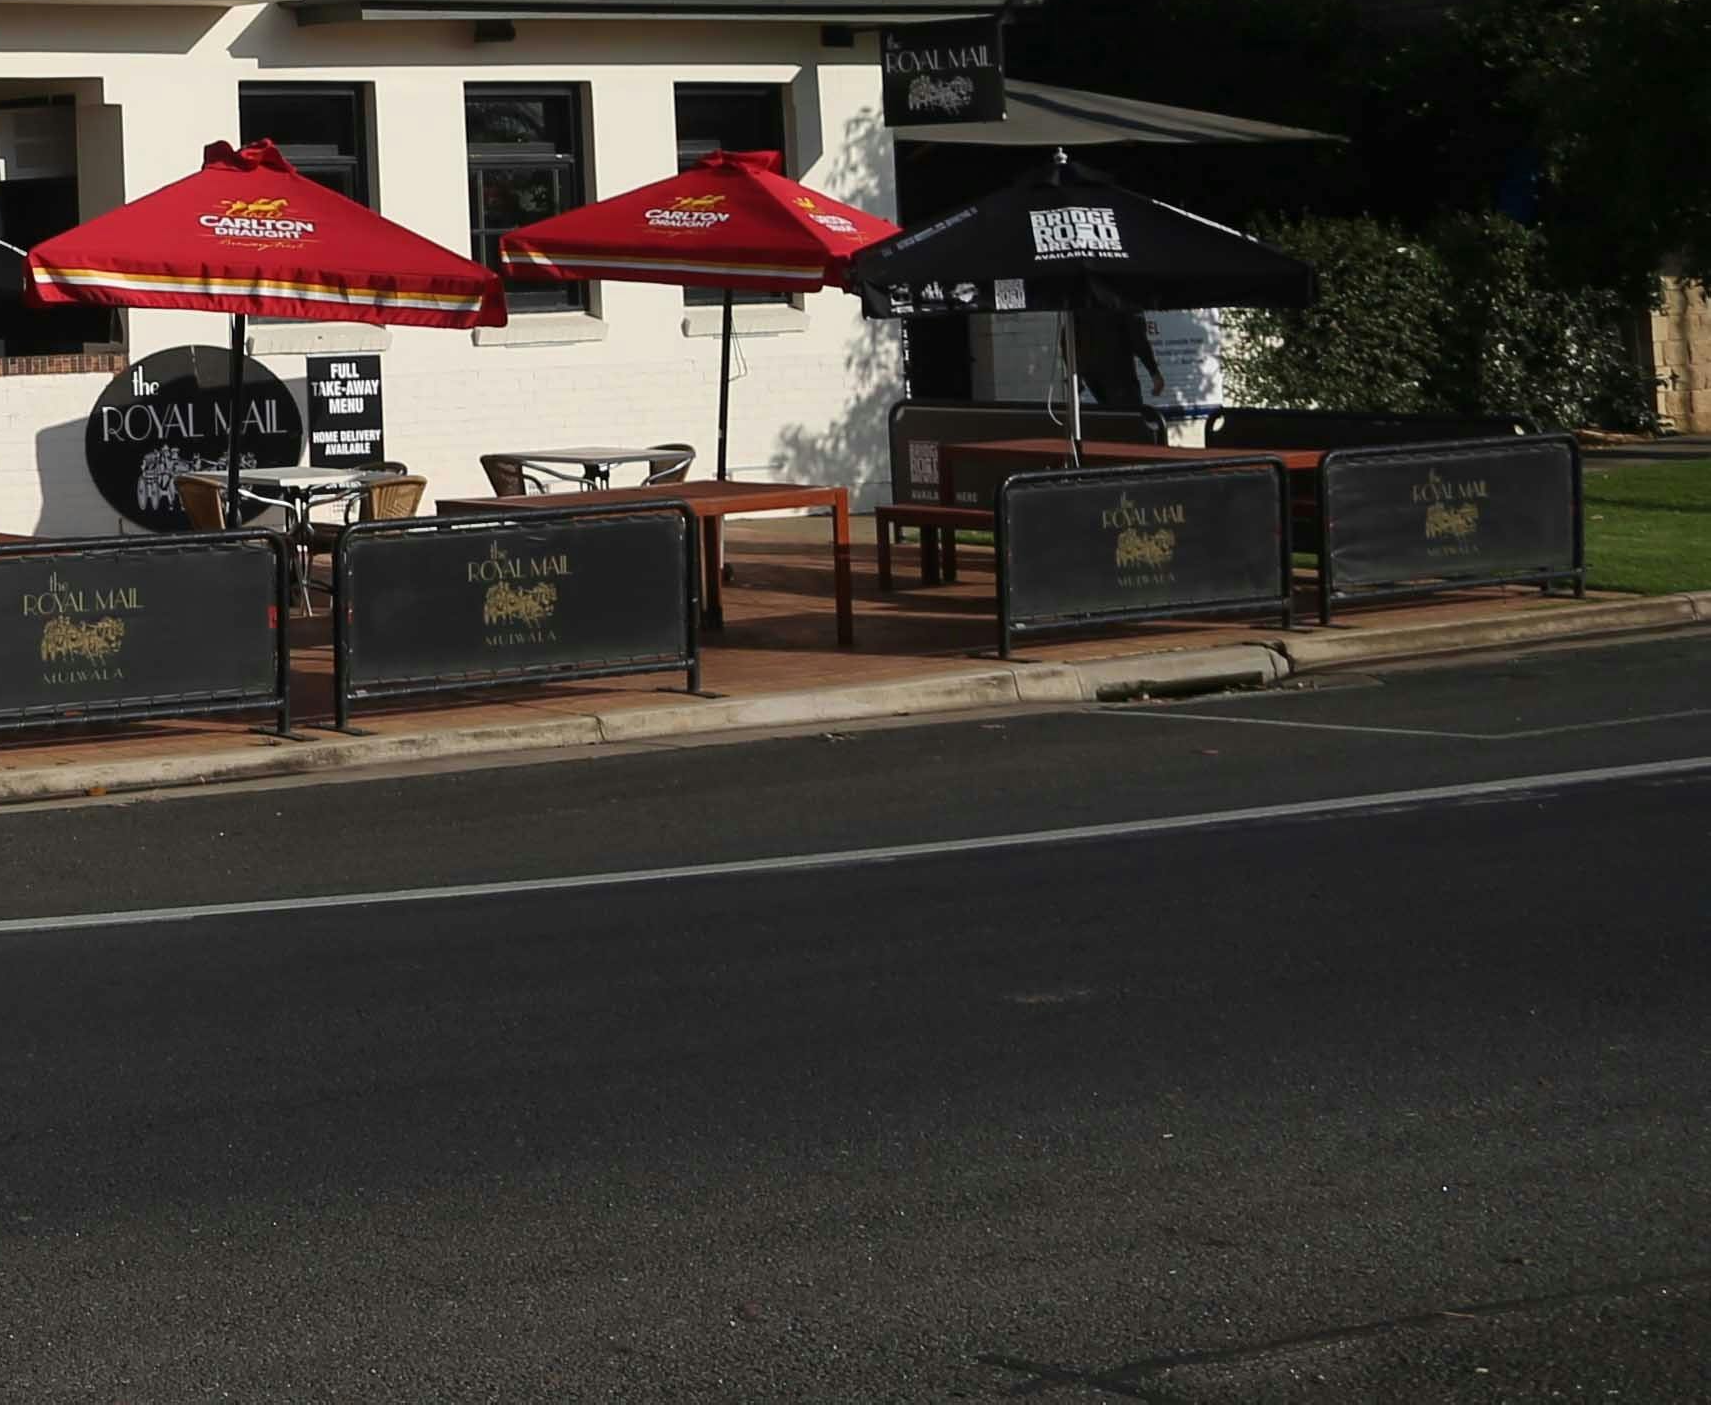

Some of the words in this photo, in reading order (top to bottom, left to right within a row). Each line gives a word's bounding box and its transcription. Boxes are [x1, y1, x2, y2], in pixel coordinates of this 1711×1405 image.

[885, 49, 946, 74] ROYAL
[948, 44, 994, 68] MAIL
[199, 215, 314, 232] CARLTON
[645, 209, 730, 222] CARLTON
[1030, 210, 1117, 227] BRIDGE
[214, 227, 302, 239] DRAUGHT
[1033, 223, 1120, 243] ROAD
[1036, 239, 1123, 253] BREWERS
[1034, 250, 1095, 261] AVAILABLE
[330, 362, 360, 379] FULL
[131, 365, 160, 397] the
[311, 379, 379, 397] TAKE-AWAY
[328, 397, 364, 414] MENU
[101, 401, 204, 442] ROYAL
[312, 431, 339, 444] HOME
[340, 429, 382, 442] DELIVERY
[325, 442, 371, 456] AVAILABLE
[467, 557, 526, 582] ROYAL
[530, 555, 574, 576] MAIL
[49, 571, 69, 592] the
[23, 591, 90, 616] ROYAL
[95, 587, 146, 610] MAIL
